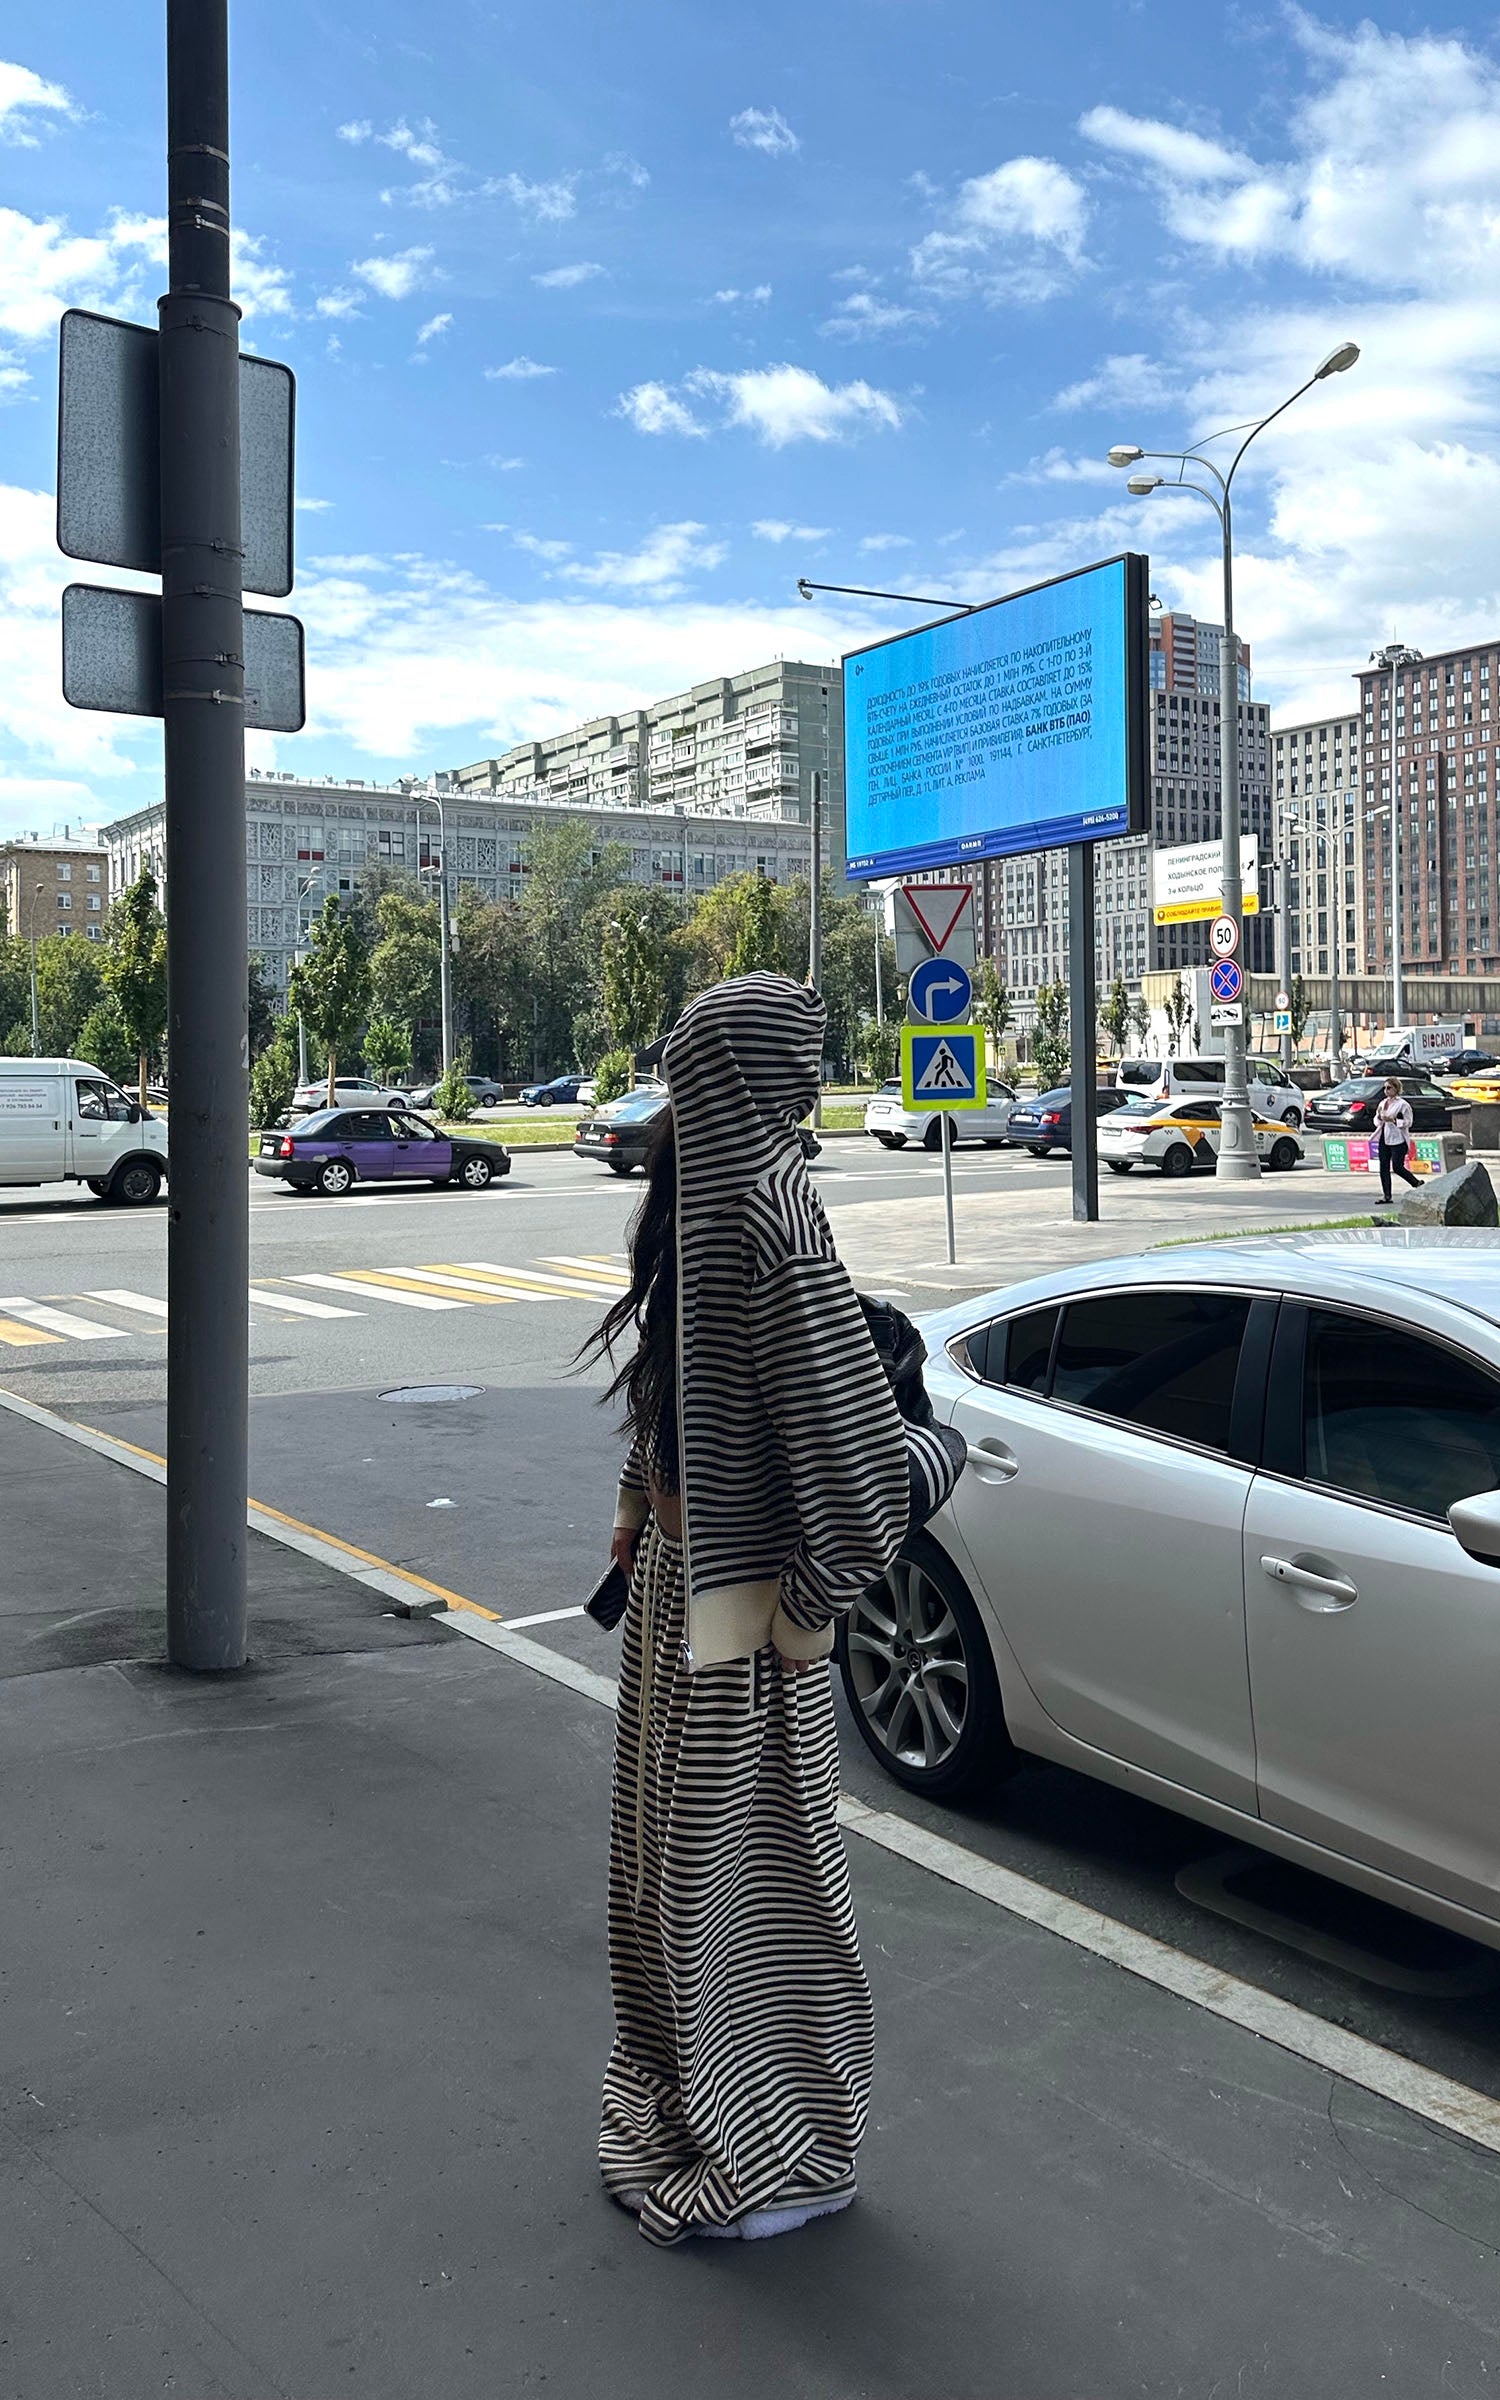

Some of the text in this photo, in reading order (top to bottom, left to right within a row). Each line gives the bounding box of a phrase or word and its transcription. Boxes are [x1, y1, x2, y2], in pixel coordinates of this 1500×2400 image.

[868, 688, 905, 710] ДОХОДНОСТЬ
[907, 684, 916, 698] ДО
[931, 670, 961, 689] ГОДОВЫХ
[963, 655, 1008, 679] НАЧИСЛЯЕТСЯ
[1011, 651, 1021, 664] ПО
[1024, 629, 1092, 660] НАКОПИТЕЛЬНОМУ
[899, 701, 908, 713] НА
[910, 686, 951, 710] ЕЖЕДНЕВНЫЙ
[954, 678, 983, 697] ОСТАТОК
[984, 675, 995, 690] ДО
[1004, 667, 1019, 682] МЛН
[1039, 660, 1044, 672] С
[1046, 654, 1062, 670] 1-ГО
[1065, 650, 1076, 664] ПО
[1079, 643, 1092, 660] 3-Й
[937, 706, 942, 716] С
[944, 701, 958, 715] 4-ГО
[960, 692, 986, 710] МЕСЯЦА
[989, 684, 1015, 702] СТАВКА
[1017, 671, 1061, 694] СОСТАВЛЯЕТ
[1064, 667, 1075, 682] ДО
[1078, 662, 1092, 676] 15%
[868, 734, 894, 750] ГОДОВЫХ
[897, 730, 909, 742] ПРИ
[912, 717, 953, 738] ВЫПОЛНЕНИИ
[956, 706, 986, 726] УСЛОВИЙ
[989, 704, 999, 717] ПО
[1052, 687, 1062, 700] НА
[1065, 678, 1092, 696] СУММУ
[869, 750, 889, 764] СВЫШЕ
[896, 744, 909, 757] МЛН
[925, 728, 968, 749] НАЧИСЛЯЕТСЯ
[970, 720, 1000, 737] БАЗОВАЯ
[1002, 712, 1029, 729] СТАВКА
[1031, 708, 1042, 721] 7%
[1043, 698, 1078, 718] ГОДОВЫХ
[1081, 694, 1092, 710] (ЗА
[913, 750, 943, 767] СЕГМЕНТА
[972, 741, 977, 752] И
[1026, 722, 1048, 738] БАНК
[1050, 718, 1065, 732] ВТБ
[902, 769, 922, 784] БАНКА
[926, 762, 952, 778] РОССИИ
[955, 768, 986, 786] РЕКЛАМА
[1168, 850, 1220, 865] ЛЕНИНГРАДСКИЙ
[1178, 883, 1204, 893] КОЛЬЦО
[1216, 928, 1231, 944] 50
